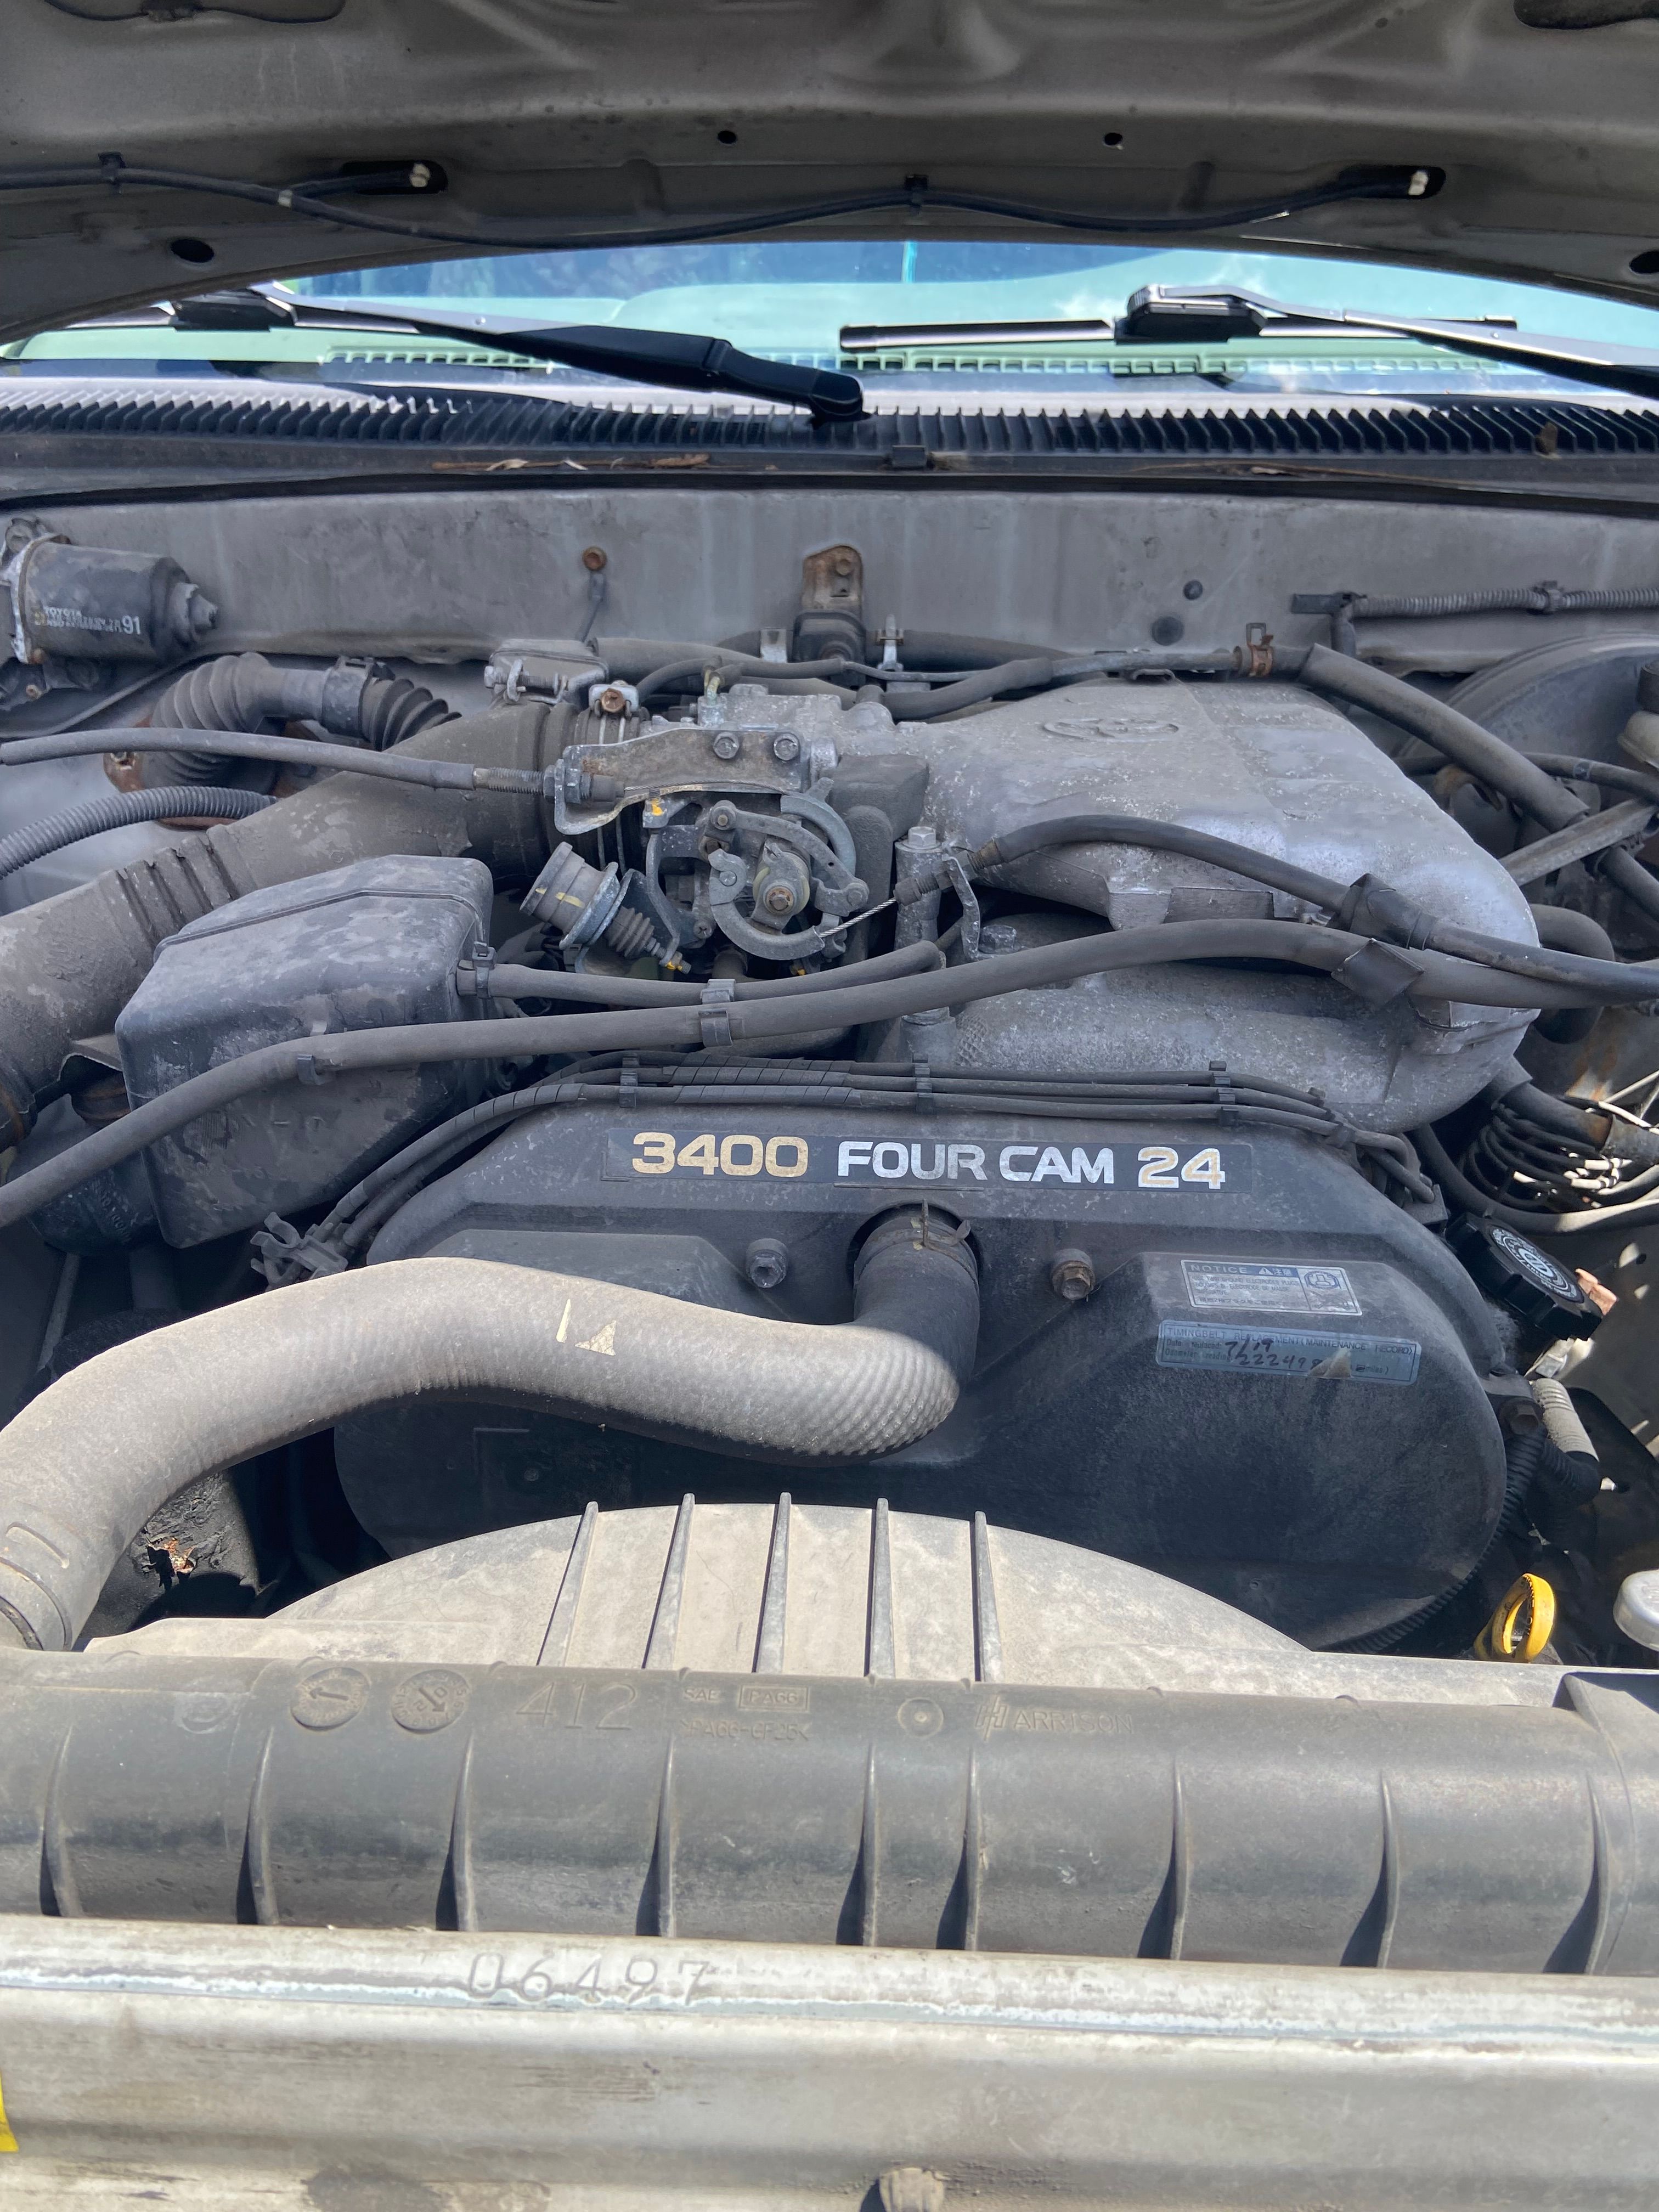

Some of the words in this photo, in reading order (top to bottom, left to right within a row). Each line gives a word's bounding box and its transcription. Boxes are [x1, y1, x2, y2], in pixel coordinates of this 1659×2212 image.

[122, 615, 141, 635] 91
[632, 1132, 809, 1178] 3400
[837, 1141, 988, 1181] FOUR
[1000, 1146, 1114, 1184] CAM
[1137, 1146, 1226, 1190] 24
[1190, 1264, 1248, 1274] NOTICE
[684, 1688, 720, 1702] SAE
[749, 1689, 798, 1704] PA66
[516, 1680, 638, 1731] 412
[469, 1952, 710, 2006] 06497
